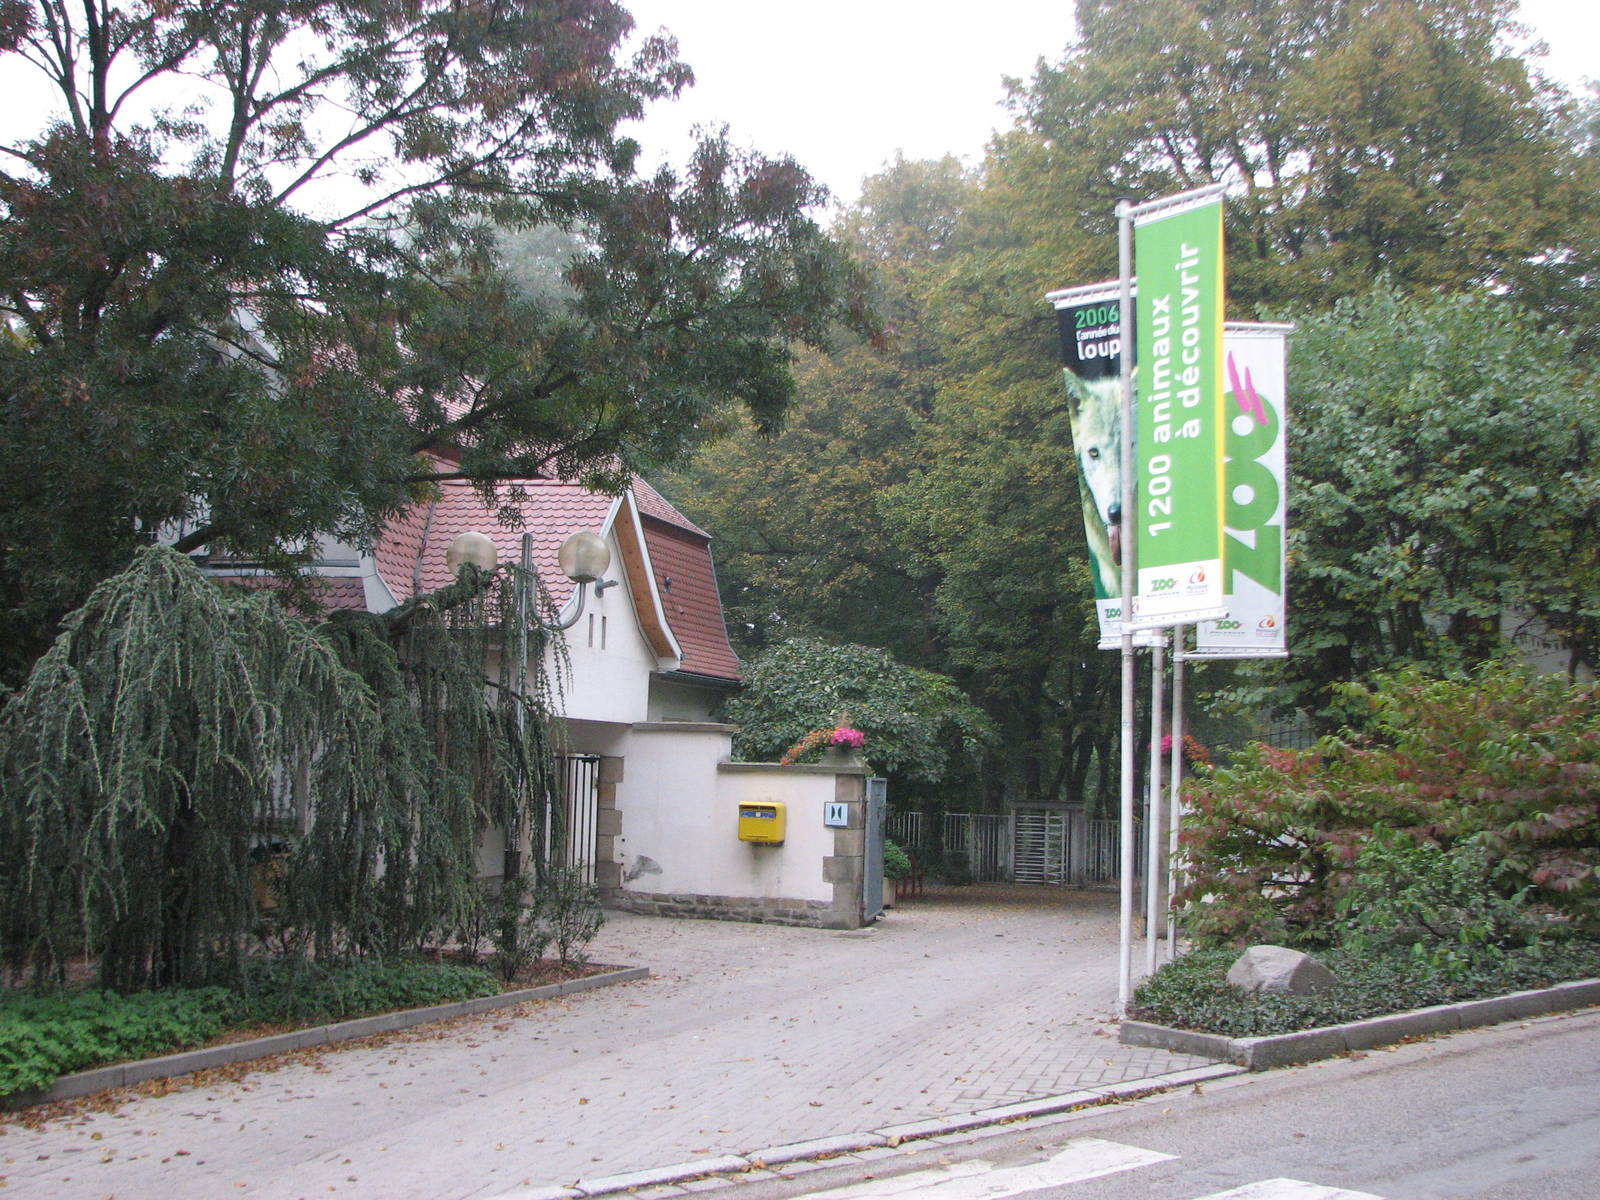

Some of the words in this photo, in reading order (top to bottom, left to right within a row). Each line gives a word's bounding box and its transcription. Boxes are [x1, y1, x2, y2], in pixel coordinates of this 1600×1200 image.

[1075, 305, 1119, 328] 2006
[1174, 242, 1201, 409] découvrir
[1107, 324, 1120, 336] du
[1077, 339, 1121, 361] loup
[1148, 294, 1171, 443] animaux
[1172, 419, 1201, 439] à
[1148, 454, 1172, 537] 1200
